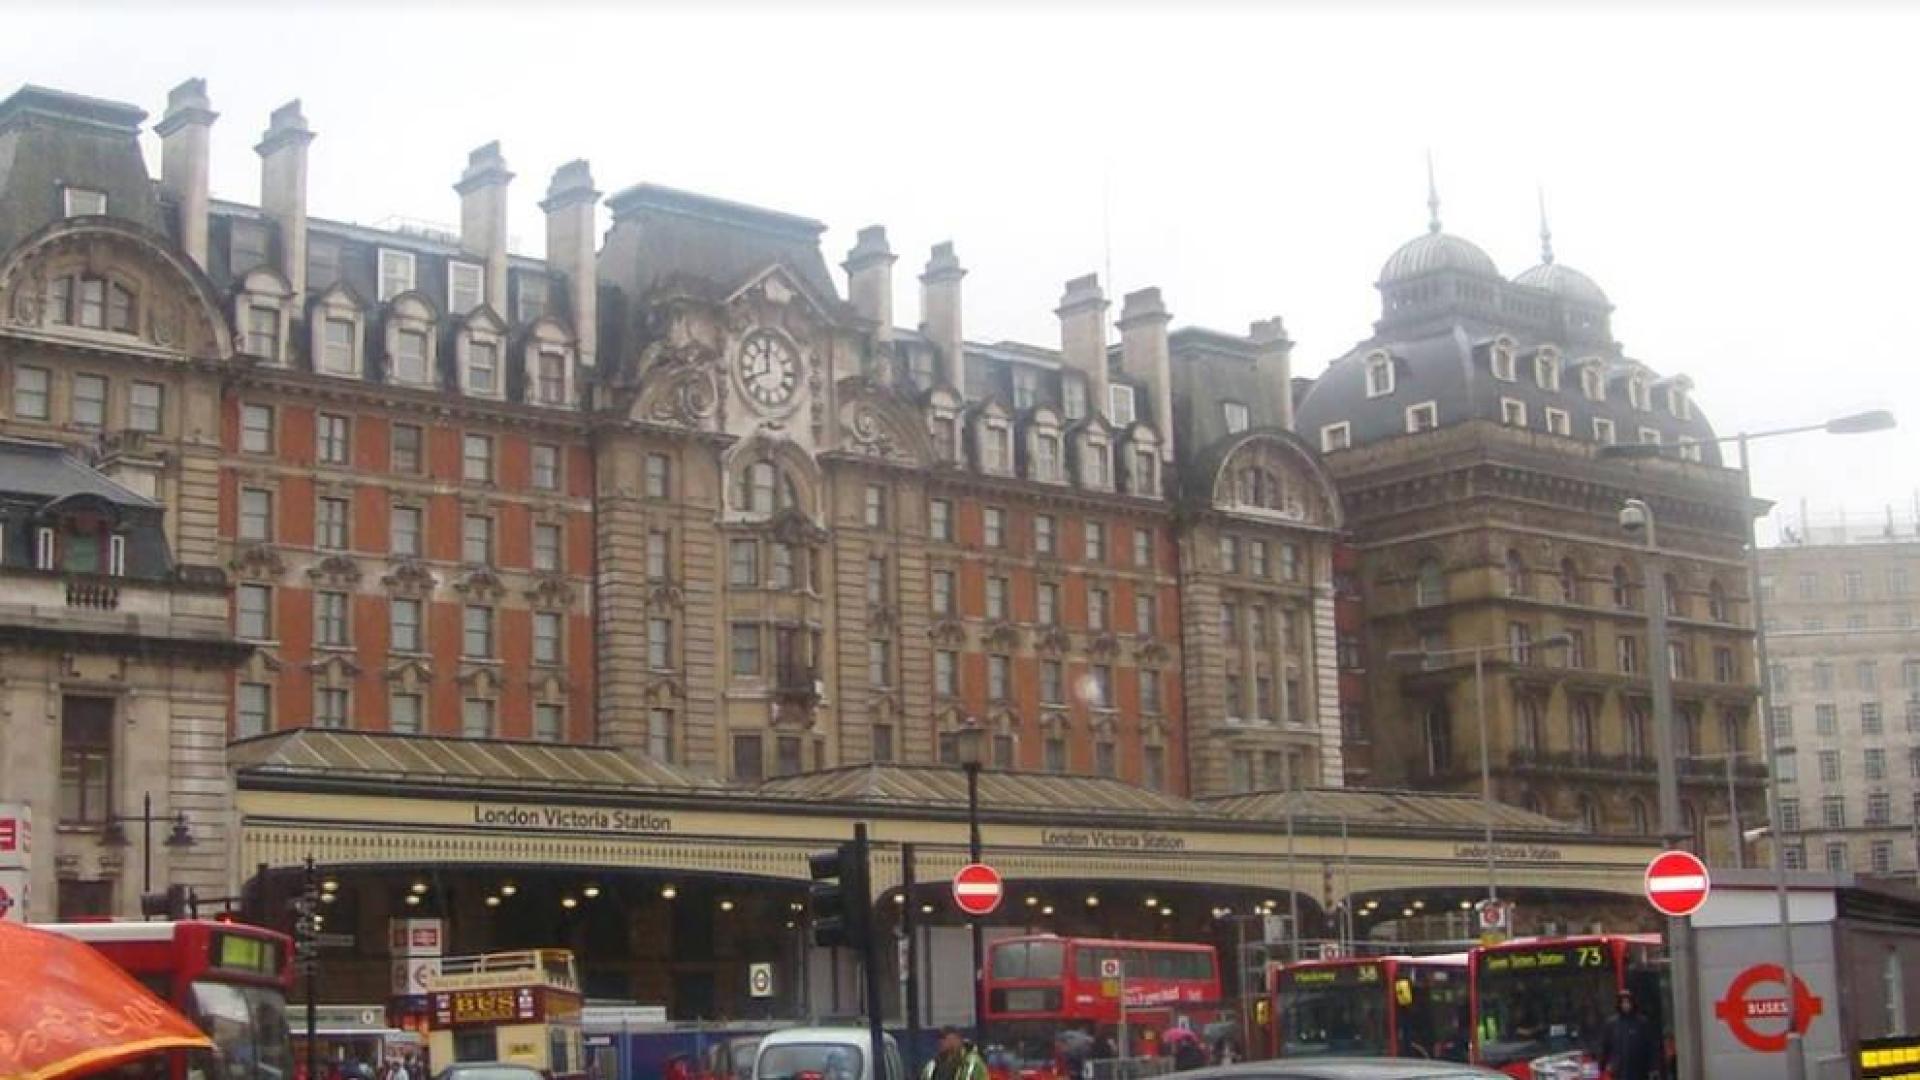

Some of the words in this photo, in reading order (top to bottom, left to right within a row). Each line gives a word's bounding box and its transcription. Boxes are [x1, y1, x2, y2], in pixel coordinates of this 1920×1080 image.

[474, 804, 540, 825] London
[544, 807, 609, 829] Victoria
[613, 810, 671, 831] Station
[1041, 829, 1088, 846] London
[1090, 830, 1139, 848] Victoria
[1141, 832, 1185, 850] Station
[1577, 946, 1602, 966] 73
[456, 993, 515, 1011] BUS
[1747, 1000, 1788, 1015] BUSES
